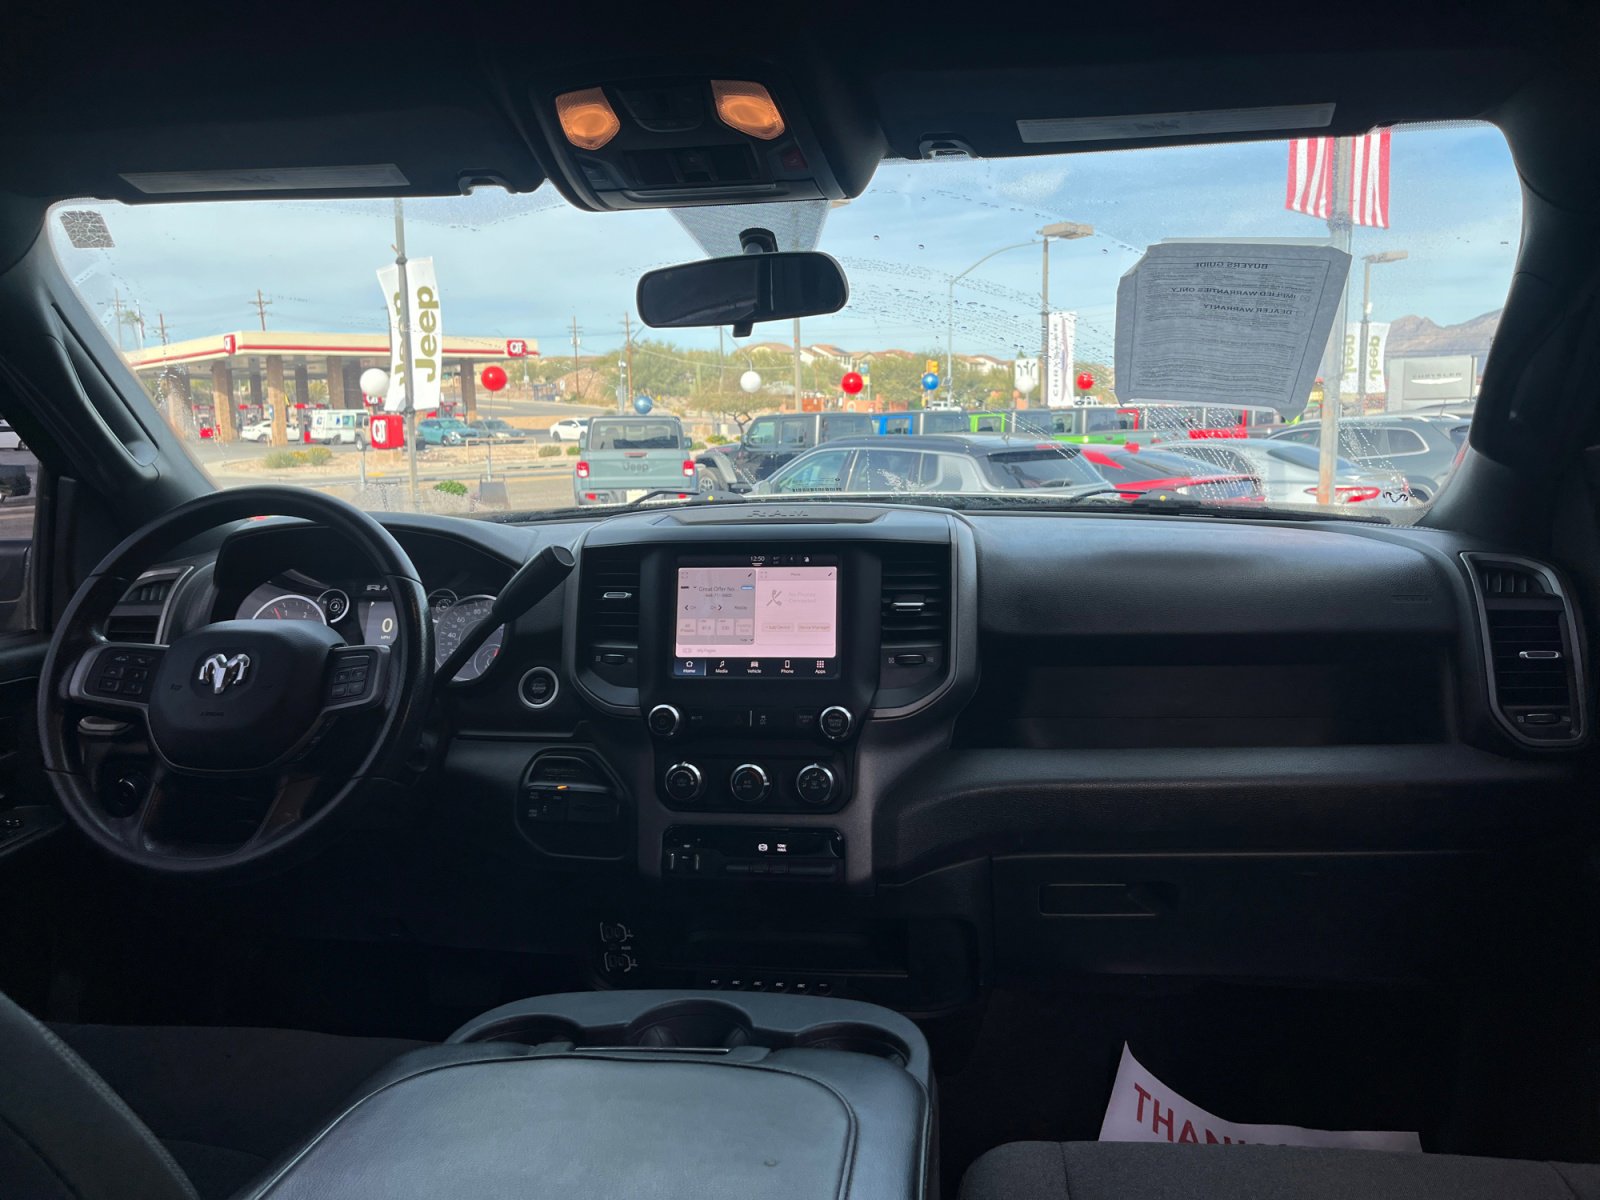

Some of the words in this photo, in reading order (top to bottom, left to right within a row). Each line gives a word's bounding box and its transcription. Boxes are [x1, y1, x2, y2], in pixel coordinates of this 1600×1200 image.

[415, 285, 440, 383] Jeep
[382, 617, 393, 633] 0
[1134, 1081, 1266, 1146] THA
